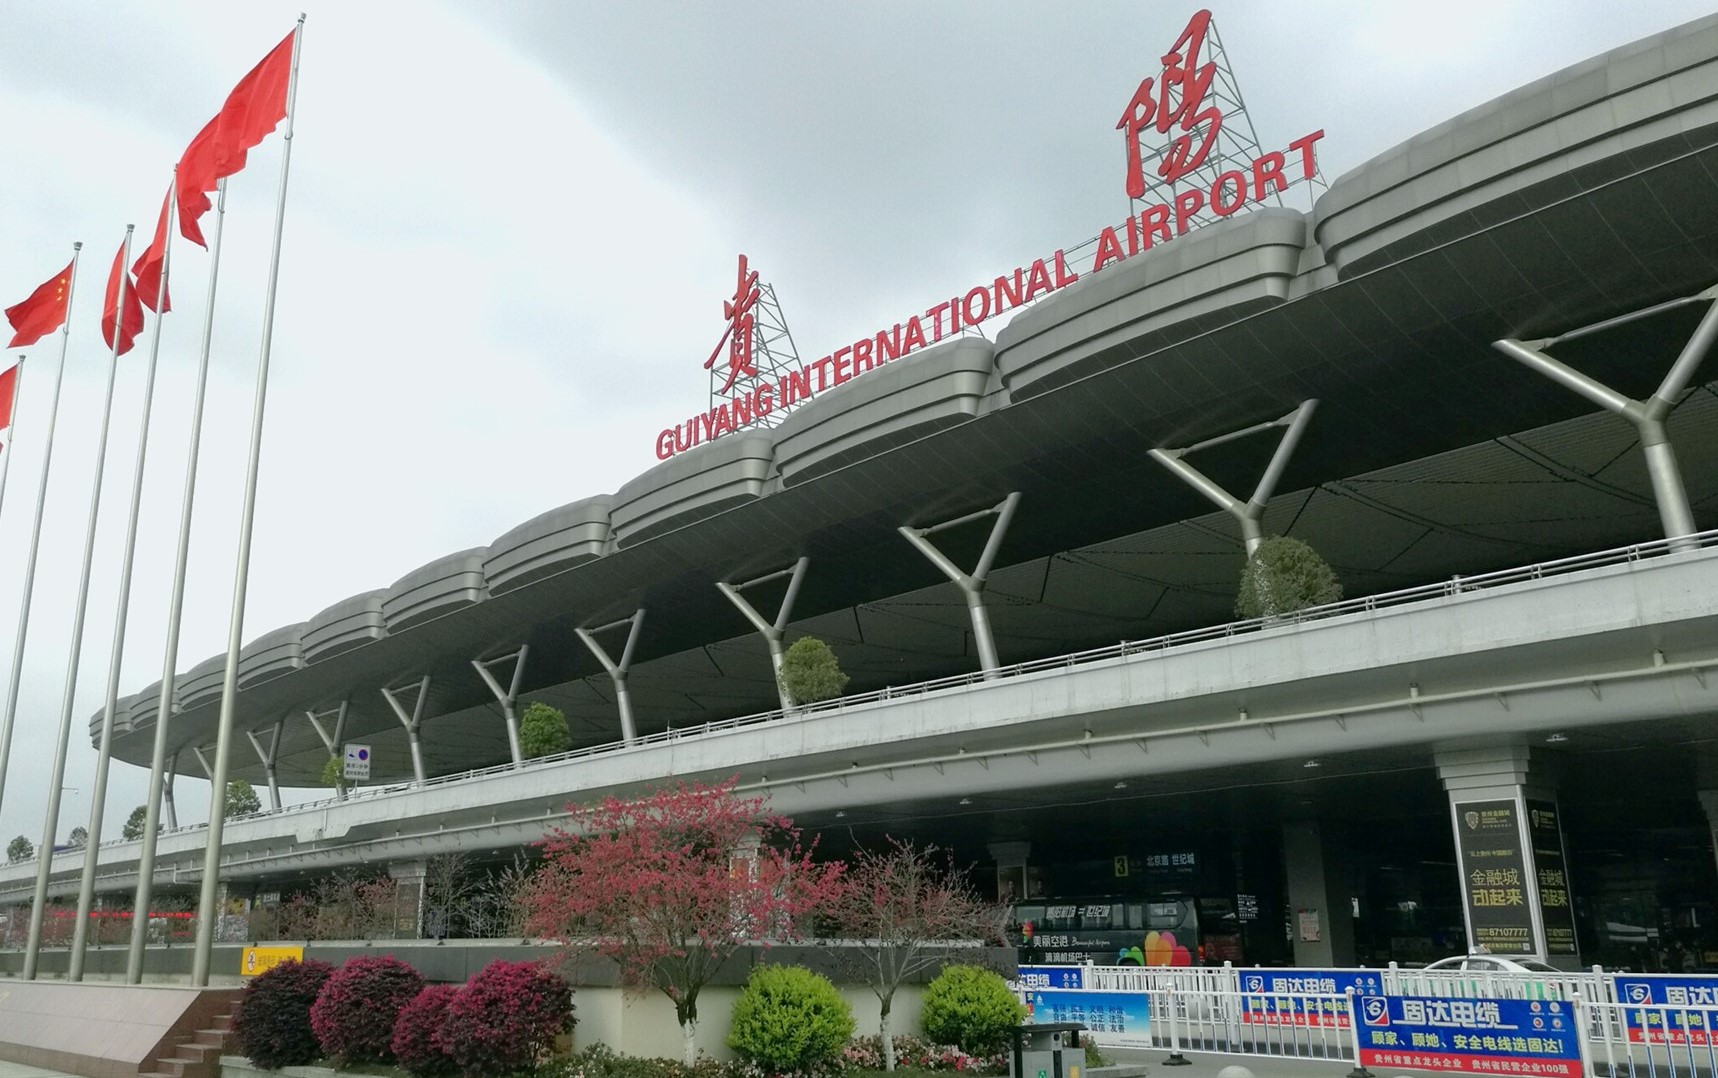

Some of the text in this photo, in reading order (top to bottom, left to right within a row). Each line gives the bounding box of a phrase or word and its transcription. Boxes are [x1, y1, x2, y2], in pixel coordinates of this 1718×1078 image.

[656, 131, 1324, 461] GUIYANG INTERNATIONAL AIRPORT
[1116, 857, 1126, 875] 3
[1146, 852, 1195, 867] 北京路 世纪城
[1470, 868, 1520, 886] 金融城
[1471, 888, 1523, 907] 动起来
[1033, 934, 1070, 948] 美丽空港
[1488, 927, 1528, 937] 87107777
[1272, 978, 1336, 994] 固达电缆
[1402, 999, 1501, 1029] 固达电缆
[1374, 1053, 1570, 1076] 贵州省重点龙头企业 贵州省民营企业100强
